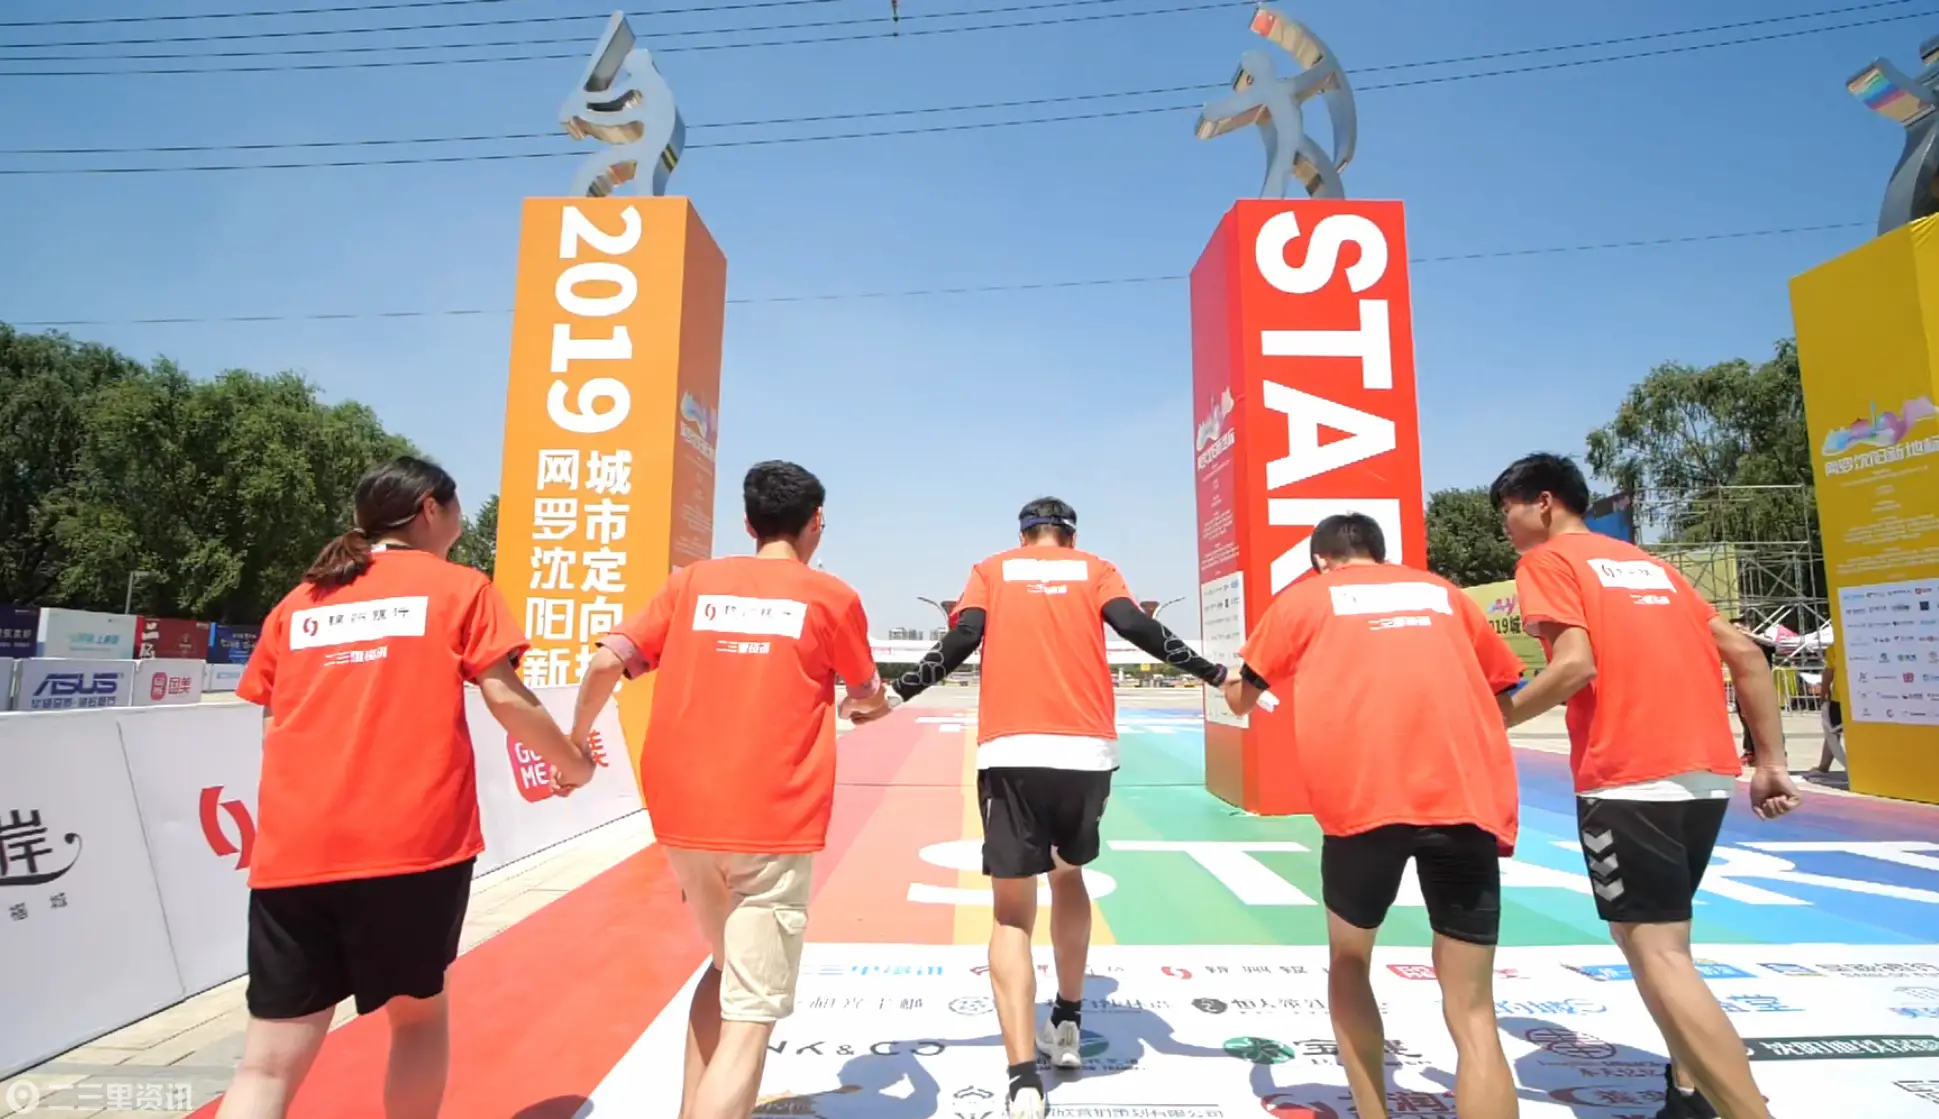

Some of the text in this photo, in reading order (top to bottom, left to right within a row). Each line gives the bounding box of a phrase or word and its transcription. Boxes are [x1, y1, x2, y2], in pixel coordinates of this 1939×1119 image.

[546, 206, 642, 433] 2019
[522, 449, 580, 687] 网罗沈阳新
[579, 449, 632, 692] 城市定向
[33, 672, 118, 696] ASUS
[520, 762, 550, 789] ME
[836, 1044, 855, 1056] &
